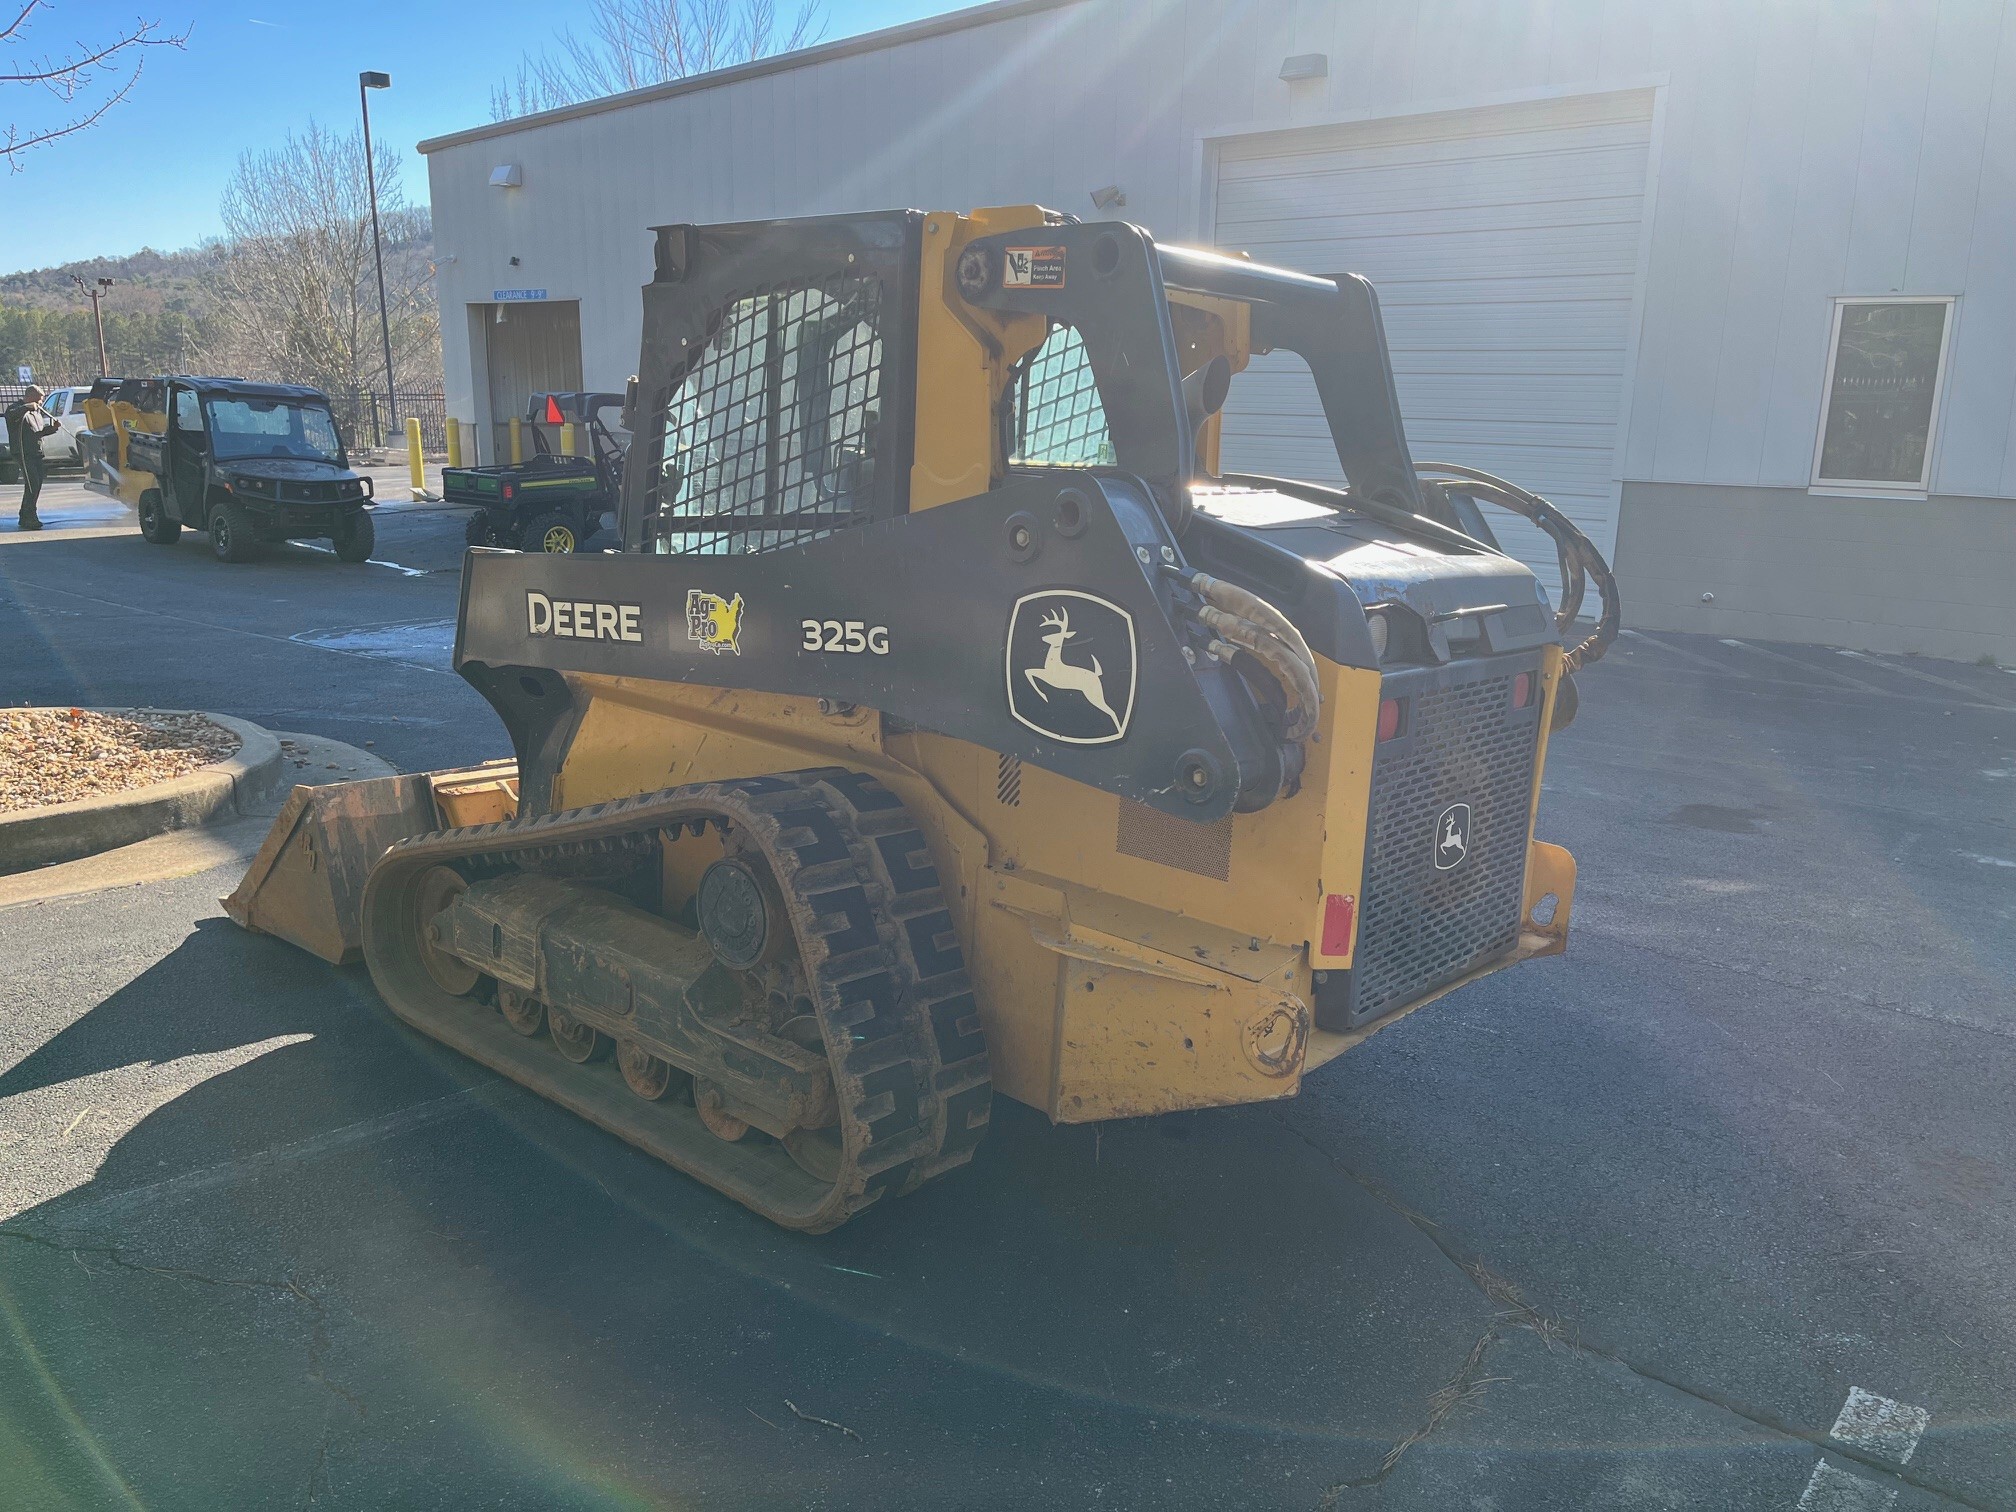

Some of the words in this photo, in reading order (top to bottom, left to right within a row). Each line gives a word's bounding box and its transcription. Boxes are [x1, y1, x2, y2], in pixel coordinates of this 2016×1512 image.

[496, 290, 527, 300] CLEARANCE
[527, 592, 642, 642] DEERE
[689, 593, 716, 620] Ag-
[690, 615, 718, 638] Pro
[802, 619, 889, 655] 325G
